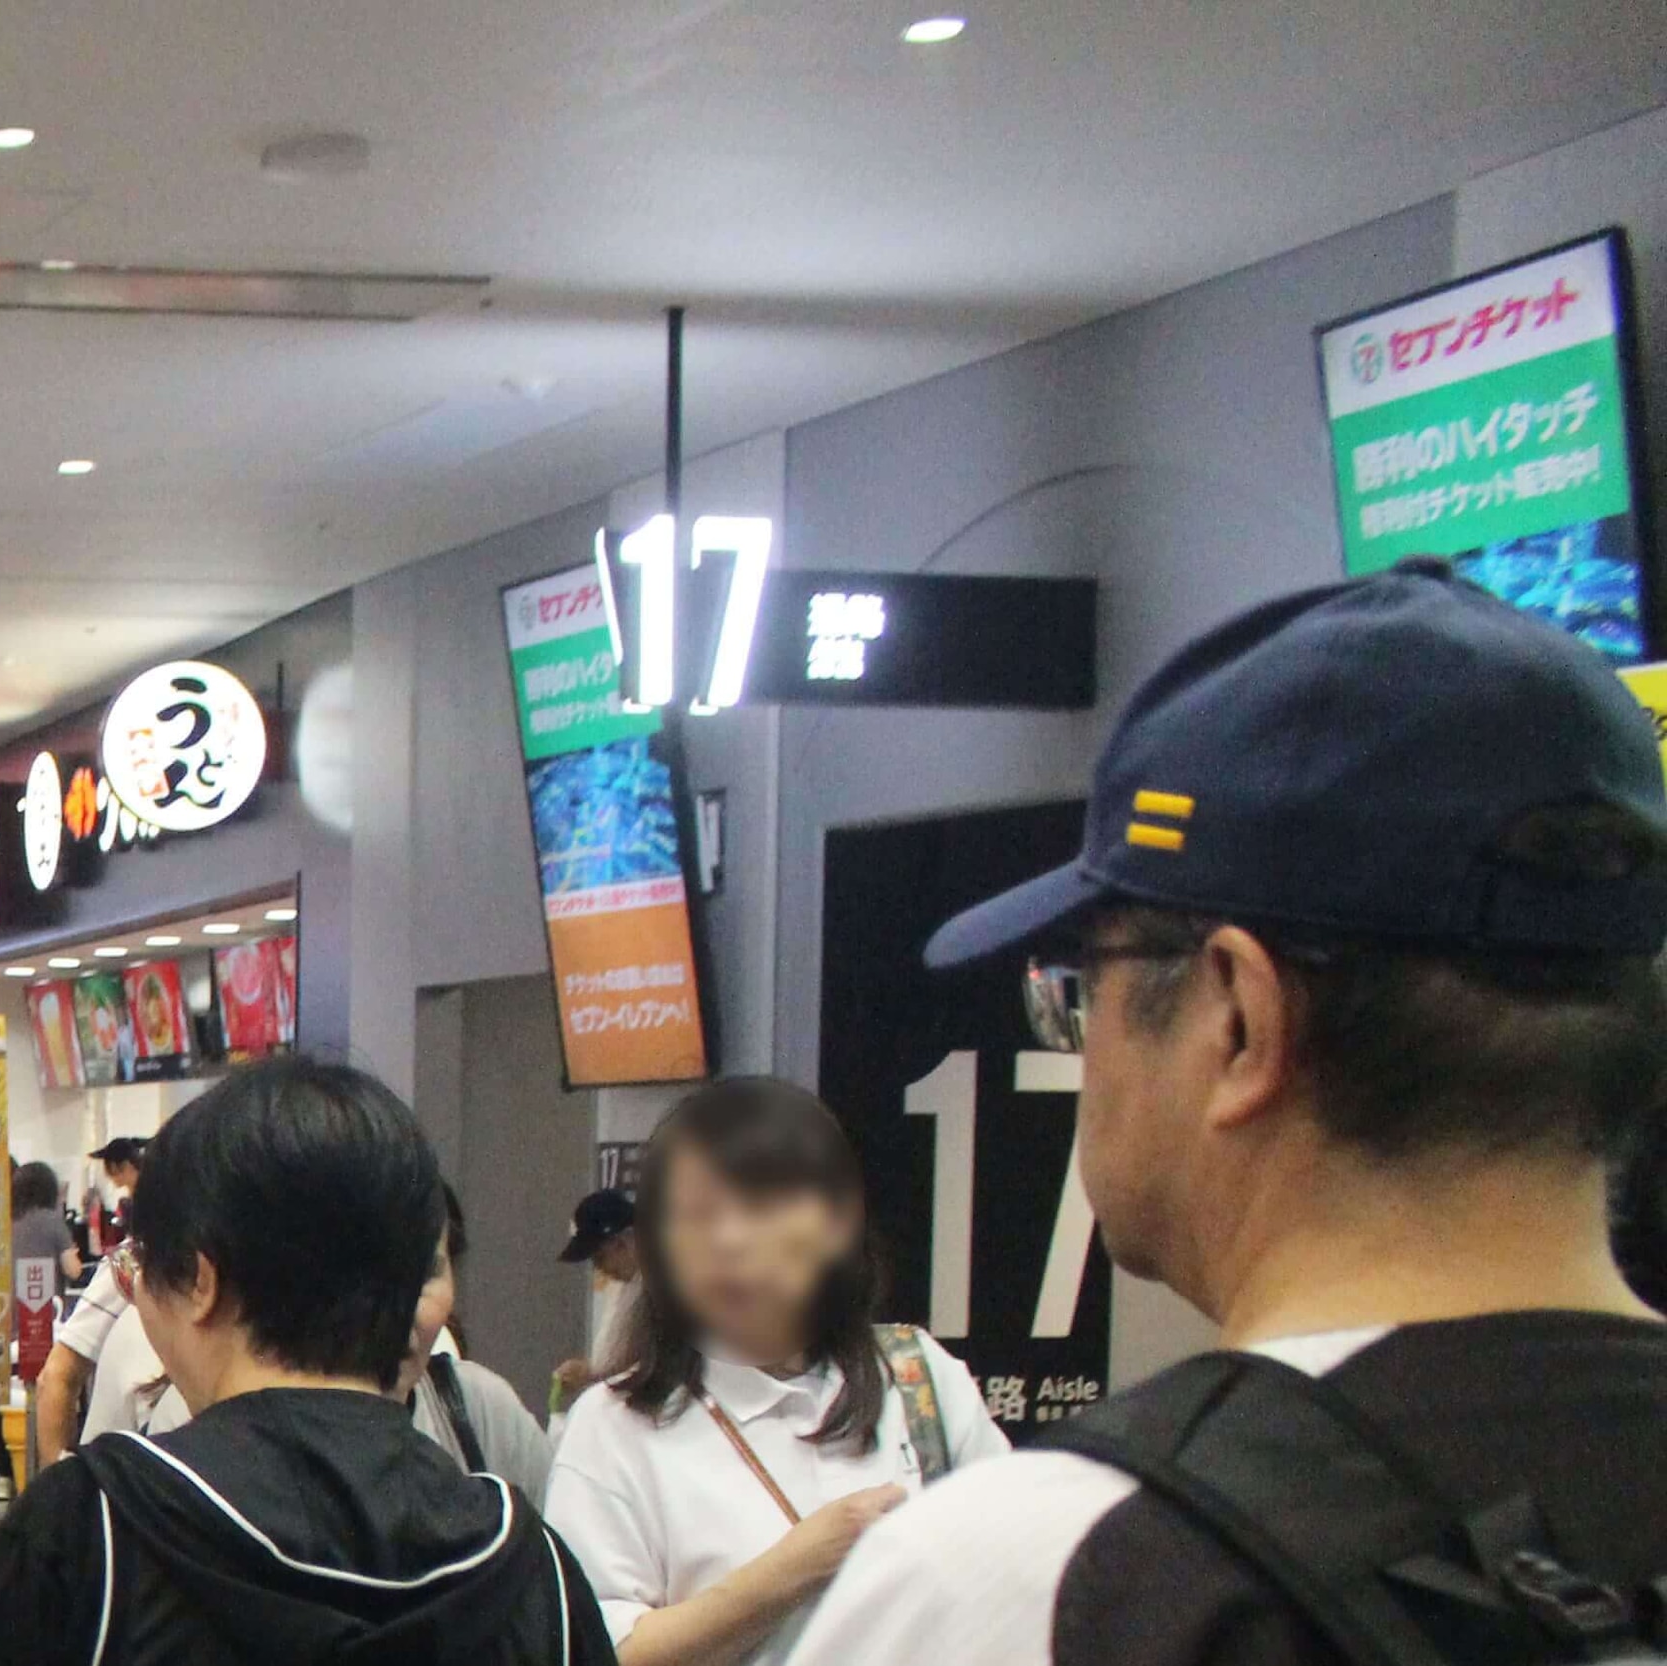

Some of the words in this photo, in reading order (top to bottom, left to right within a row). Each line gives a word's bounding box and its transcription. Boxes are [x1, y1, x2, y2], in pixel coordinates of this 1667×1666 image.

[620, 514, 773, 718] 17
[904, 1051, 1094, 1339] 17
[1037, 1374, 1100, 1401] Aisle
